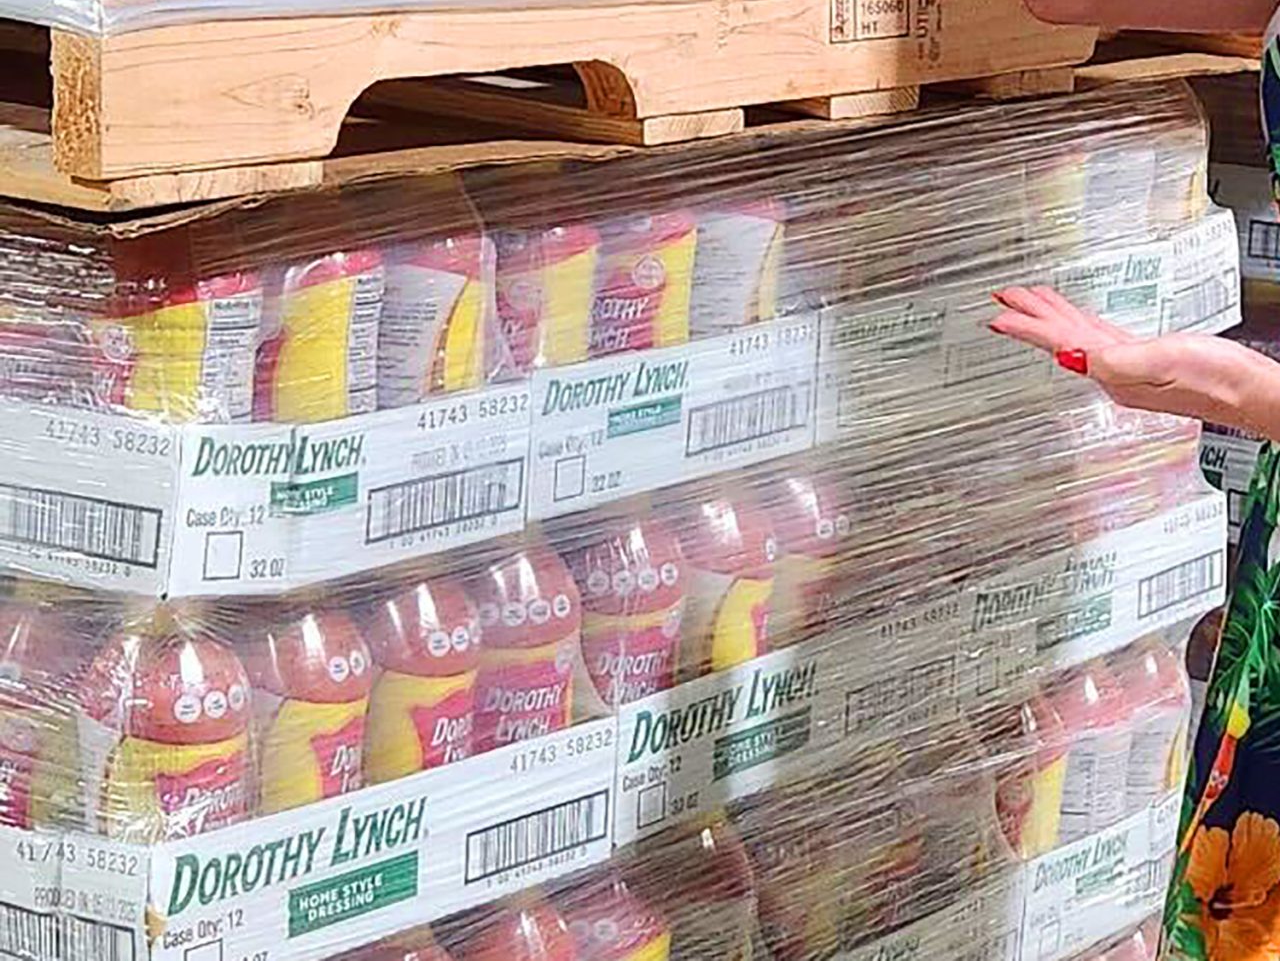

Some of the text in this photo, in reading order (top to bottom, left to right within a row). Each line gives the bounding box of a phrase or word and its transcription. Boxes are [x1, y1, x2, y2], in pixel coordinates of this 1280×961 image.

[862, 0, 904, 15] 165060
[862, 22, 878, 34] HT
[542, 372, 631, 416] DOROTHY
[632, 361, 687, 397] LYNCH
[417, 393, 529, 430] 41743 58232
[44, 420, 171, 456] 41743 58232
[192, 436, 295, 478] DOROTHY
[298, 433, 364, 475] LYNCH
[591, 473, 606, 492] 32
[186, 508, 217, 528] Case
[248, 505, 264, 526] 12
[250, 558, 285, 577] 32 OZ
[486, 683, 566, 712] DOROTHY
[627, 661, 819, 762] DOROTHY LYNCH
[510, 729, 613, 773] 41743 58232
[623, 769, 646, 791] Case
[88, 848, 138, 876] 58232
[167, 796, 428, 917] DOROTHY LYNCH
[300, 874, 383, 910] HOME STYLE
[308, 890, 374, 920] DRESSING
[163, 910, 244, 949] Case Qty: 12
